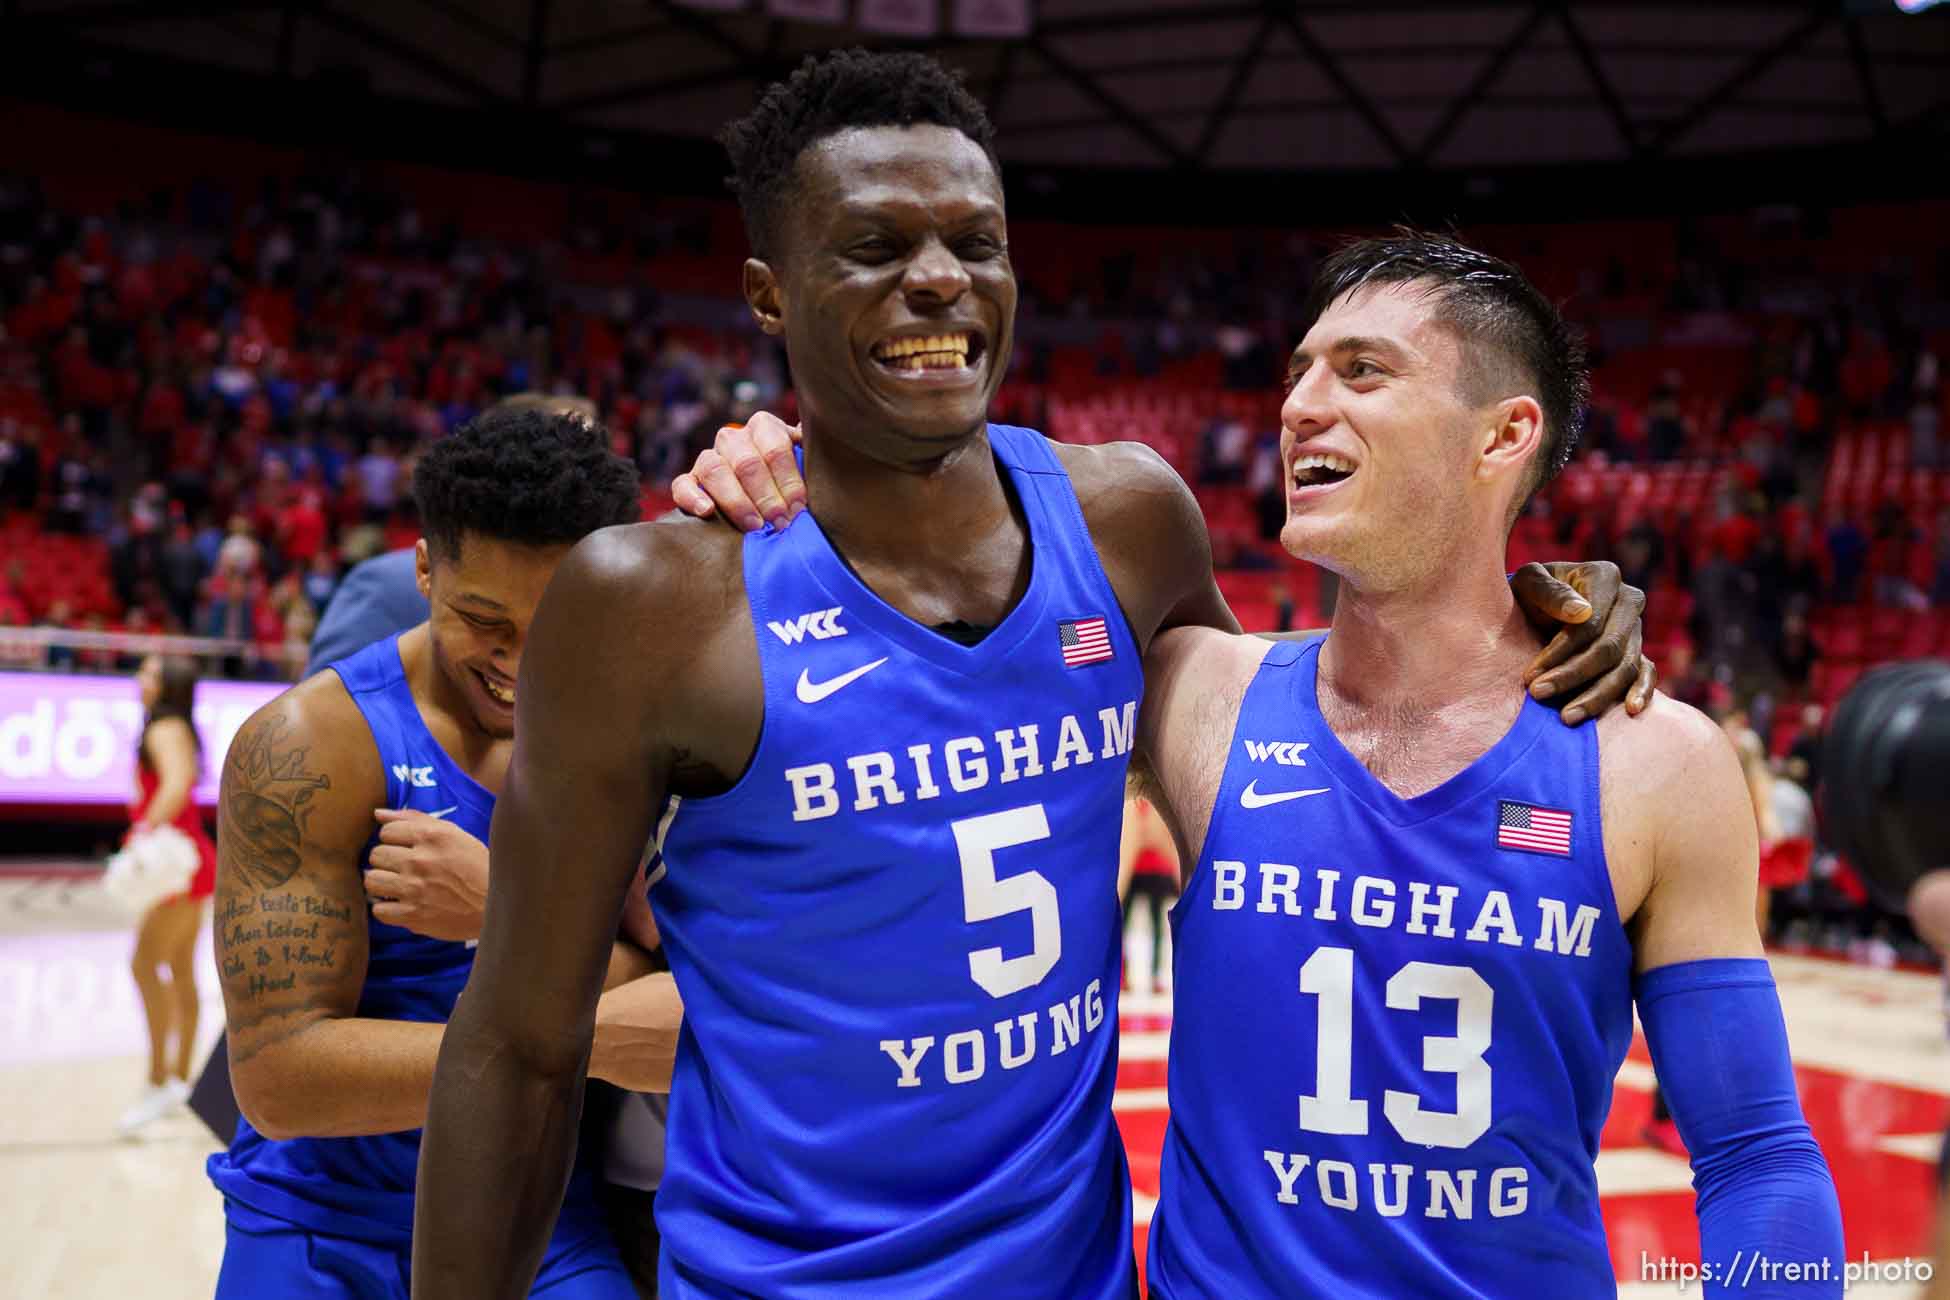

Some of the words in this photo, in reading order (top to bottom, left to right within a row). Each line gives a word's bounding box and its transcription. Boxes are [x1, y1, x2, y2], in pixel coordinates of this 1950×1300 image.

[766, 605, 849, 646] WCC
[392, 764, 437, 788] WCC
[784, 701, 1137, 822] BRIGHAM
[1244, 739, 1310, 767] WCC
[951, 803, 1062, 998] 5
[1212, 860, 1601, 958] BRIGHAM
[879, 978, 1104, 1087] YOUNG
[1299, 946, 1494, 1149] 13
[1263, 1150, 1528, 1220] YOUNG
